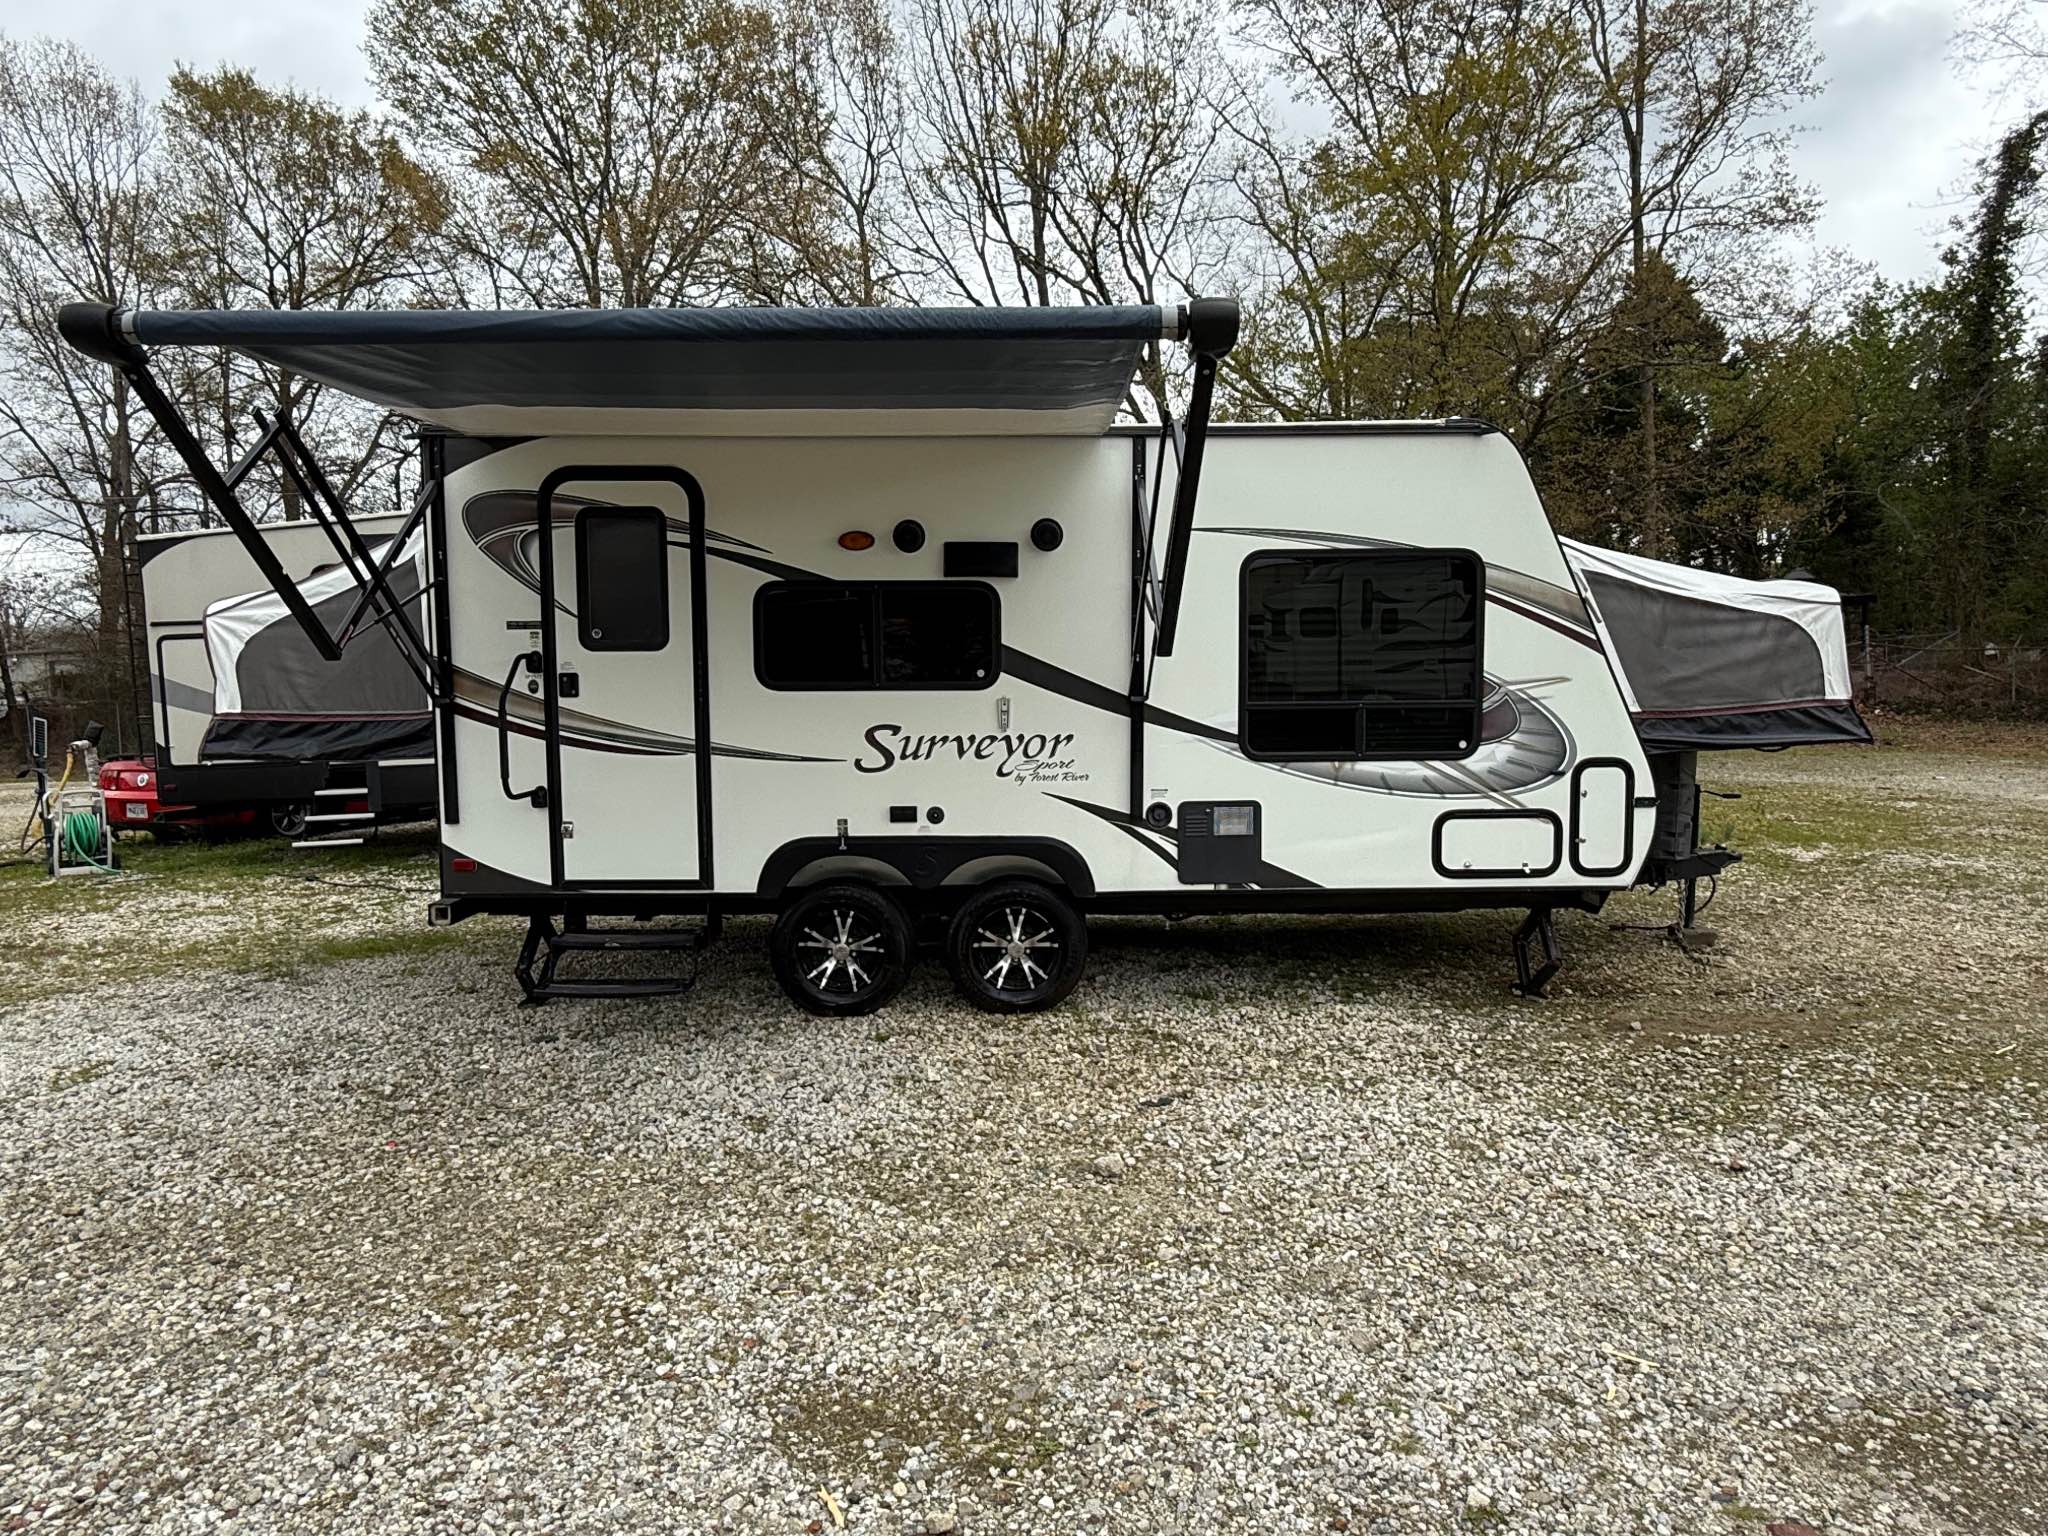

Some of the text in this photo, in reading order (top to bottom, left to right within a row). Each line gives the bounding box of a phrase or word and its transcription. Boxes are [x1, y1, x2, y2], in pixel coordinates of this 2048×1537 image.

[854, 723, 1075, 778] Surveyor
[1014, 759, 1075, 773] Sport
[1014, 771, 1090, 786] by Forest River
